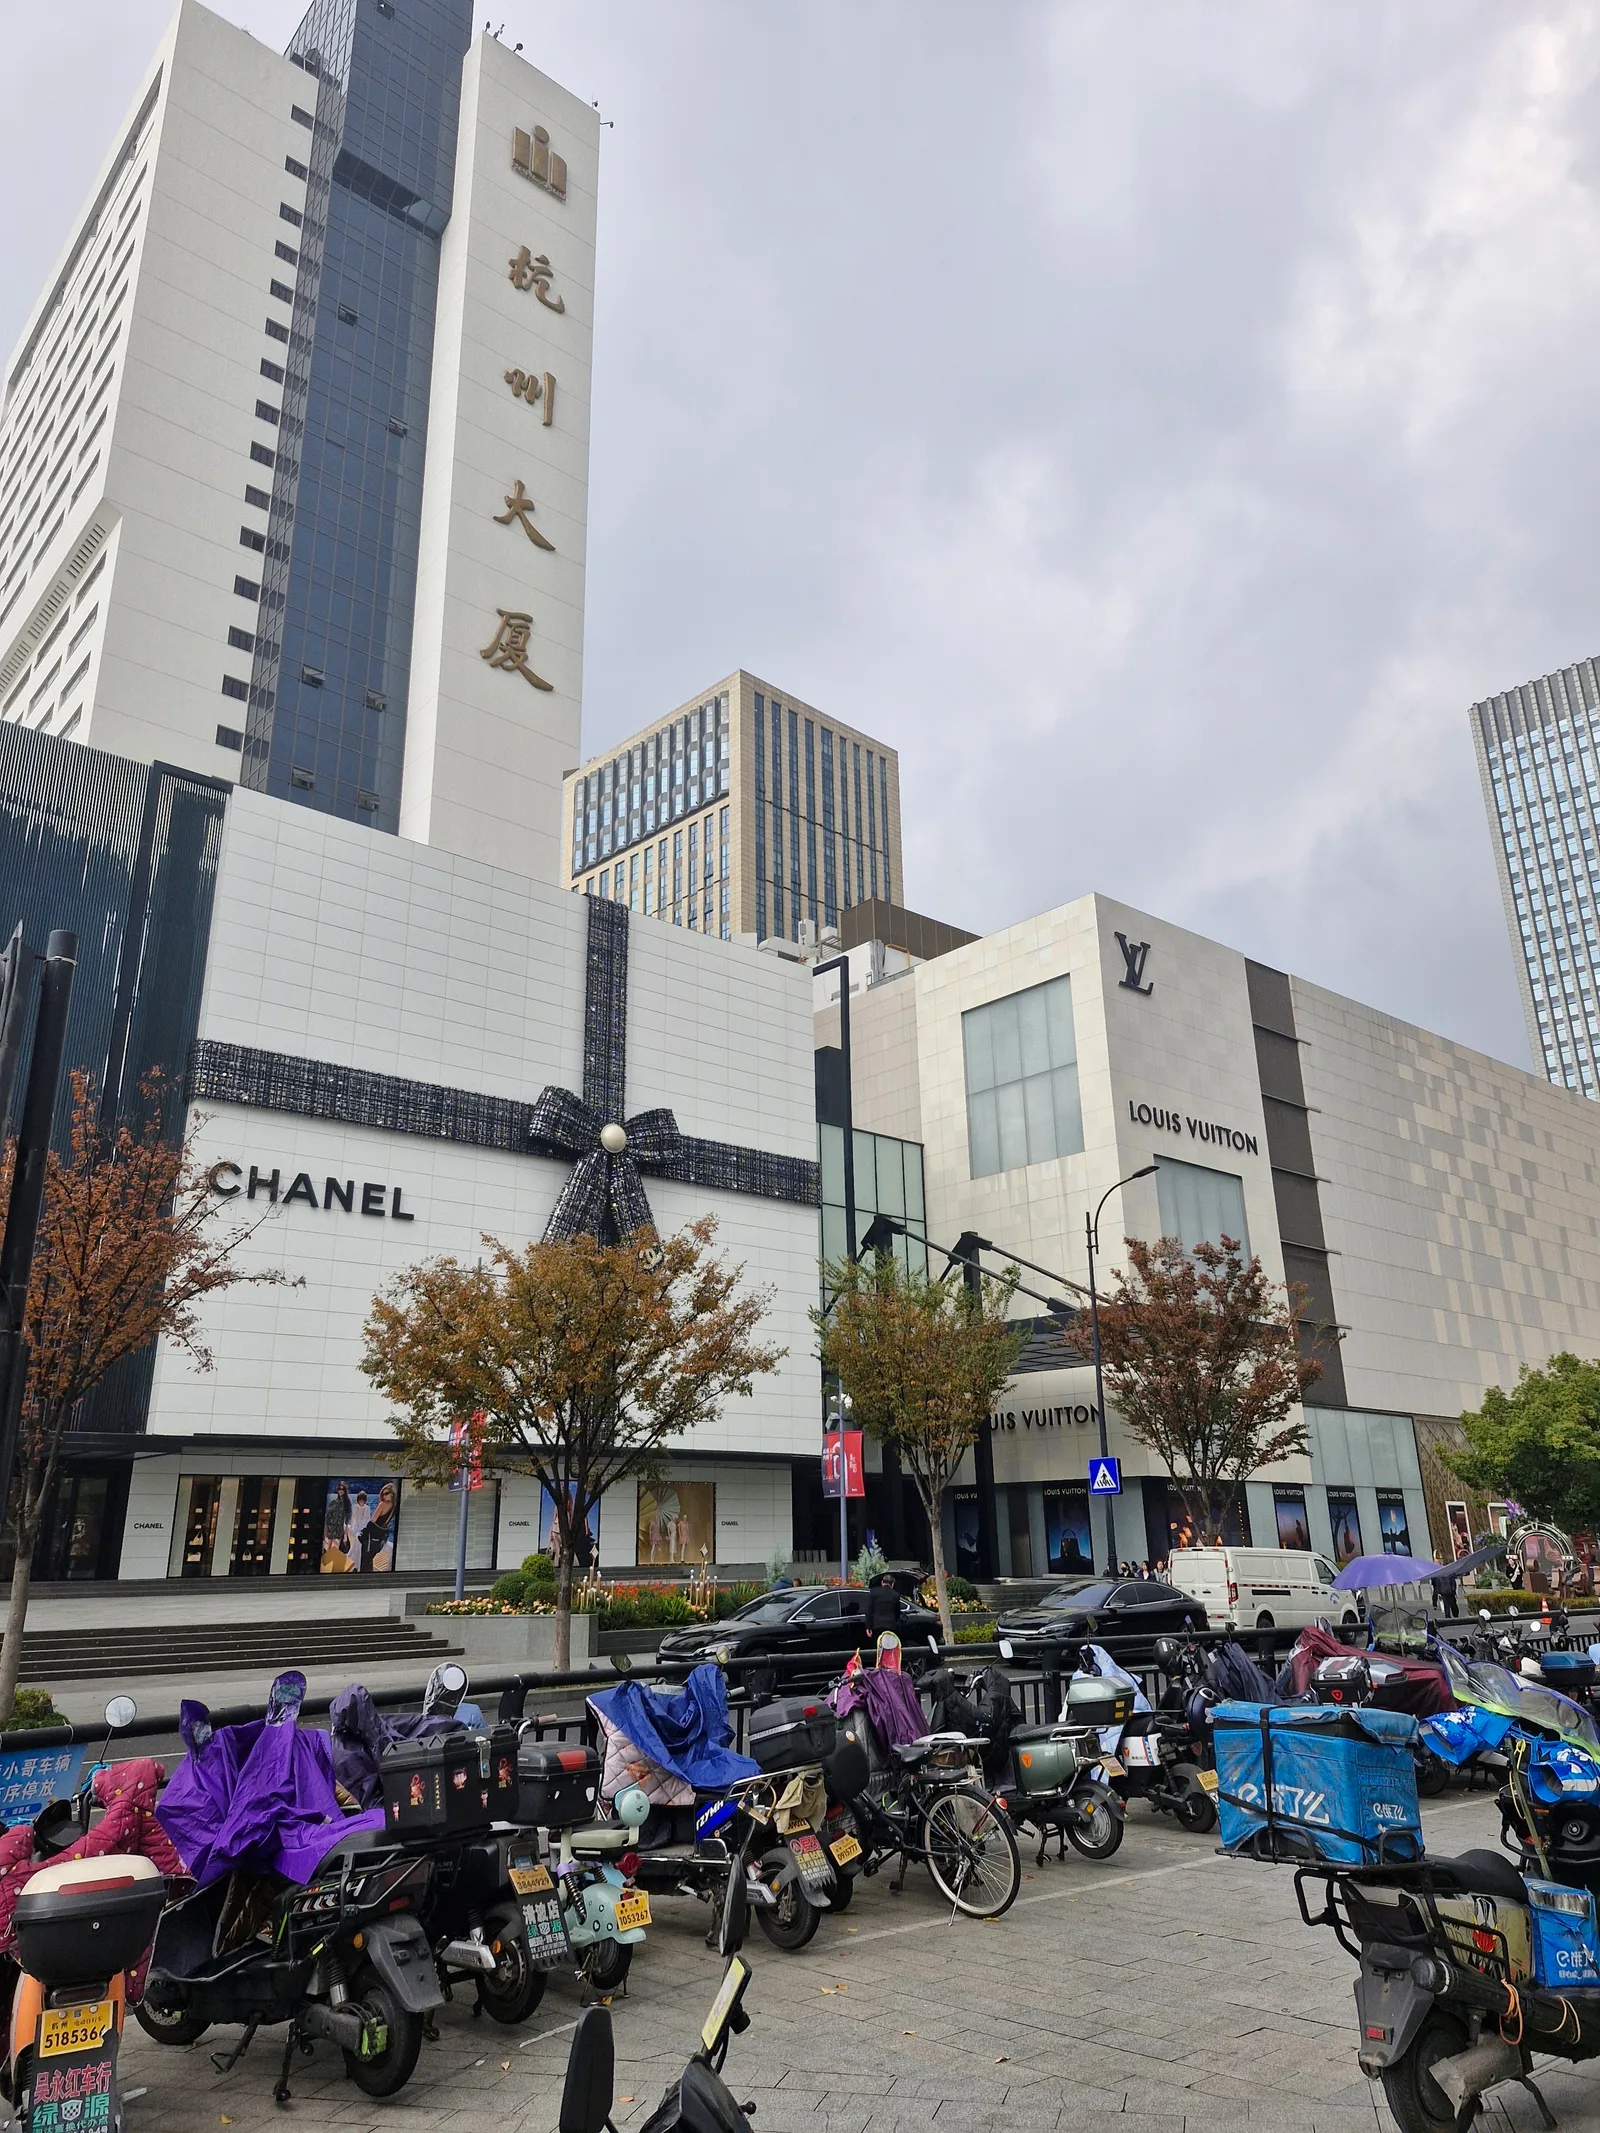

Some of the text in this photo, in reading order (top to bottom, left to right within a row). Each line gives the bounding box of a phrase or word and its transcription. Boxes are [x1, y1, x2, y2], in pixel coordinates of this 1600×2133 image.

[480, 245, 566, 692] 杭州大厦
[1129, 1100, 1258, 1156] LOUIS VUITTON
[208, 1161, 415, 1221] CHANEL
[989, 1411, 1017, 1431] UIS
[1044, 1487, 1087, 1496] LOUIS VUITTON
[1286, 1488, 1304, 1496] VUITTON
[1327, 1490, 1339, 1498] LOUIS
[133, 1522, 164, 1530] CHANEL
[0, 1753, 72, 1780] 小哥车辆
[619, 1910, 648, 1925] 1053267
[34, 2061, 112, 2105] 吴永红车行
